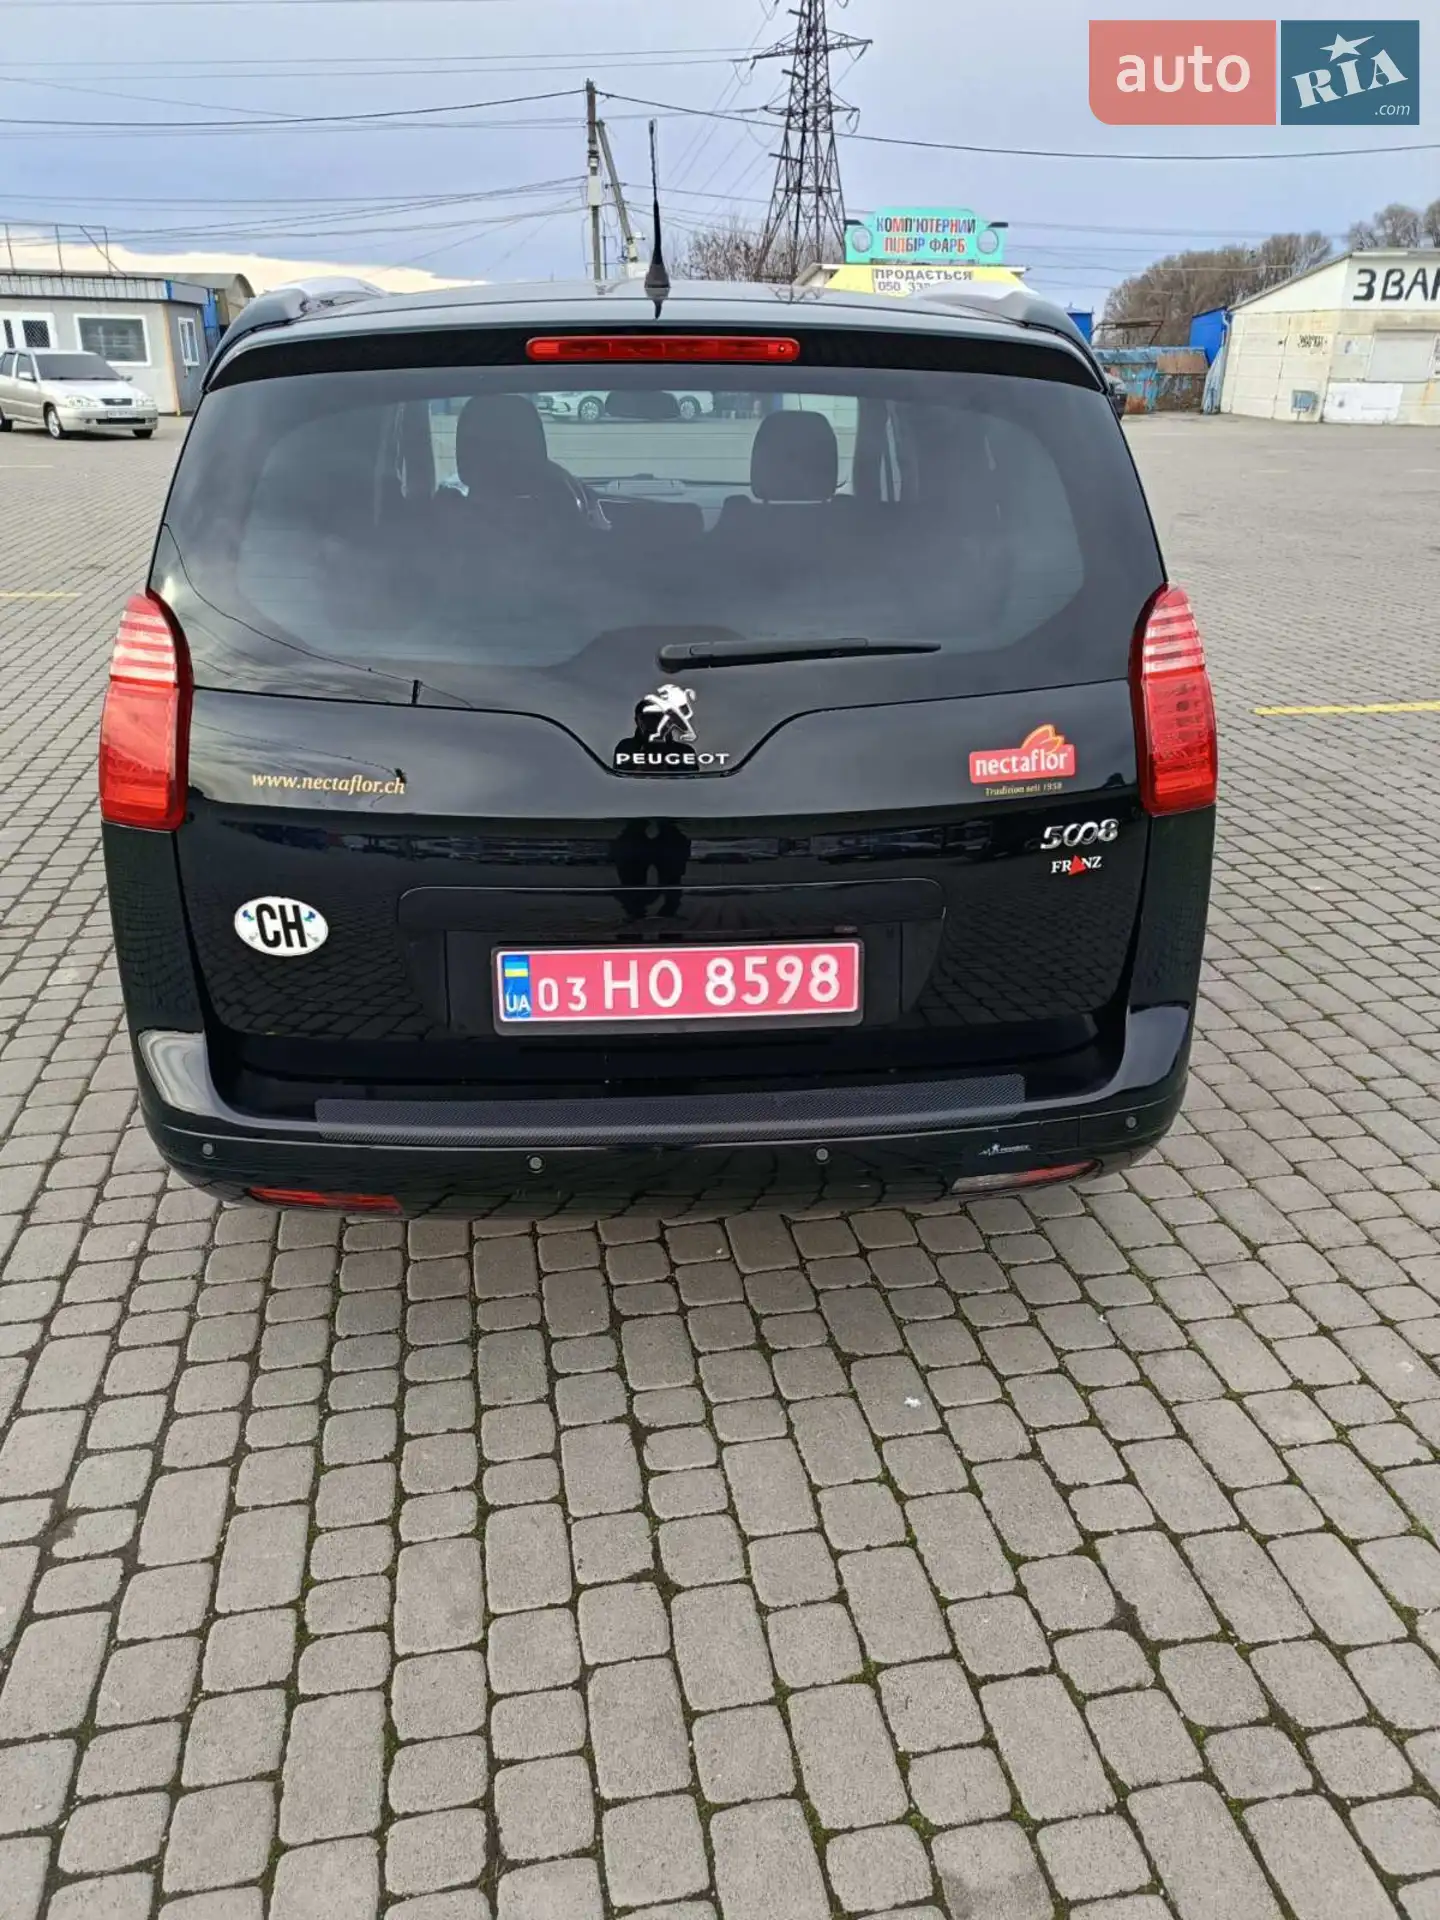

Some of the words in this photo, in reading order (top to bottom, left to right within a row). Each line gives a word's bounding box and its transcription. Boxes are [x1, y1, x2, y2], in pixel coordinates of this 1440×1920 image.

[929, 238, 966, 253] ФАРБ
[875, 268, 973, 281] ПРОДАЄТЬСЯ
[616, 752, 730, 765] PEUGEOT
[975, 749, 1068, 776] nectaflor
[251, 773, 405, 796] www.nectaflor.ch
[1040, 818, 1120, 849] 5008
[256, 903, 308, 948] CH
[538, 977, 588, 1012] 03
[603, 959, 683, 1009] HO
[705, 954, 841, 1006] 8598
[505, 992, 531, 1013] UA
